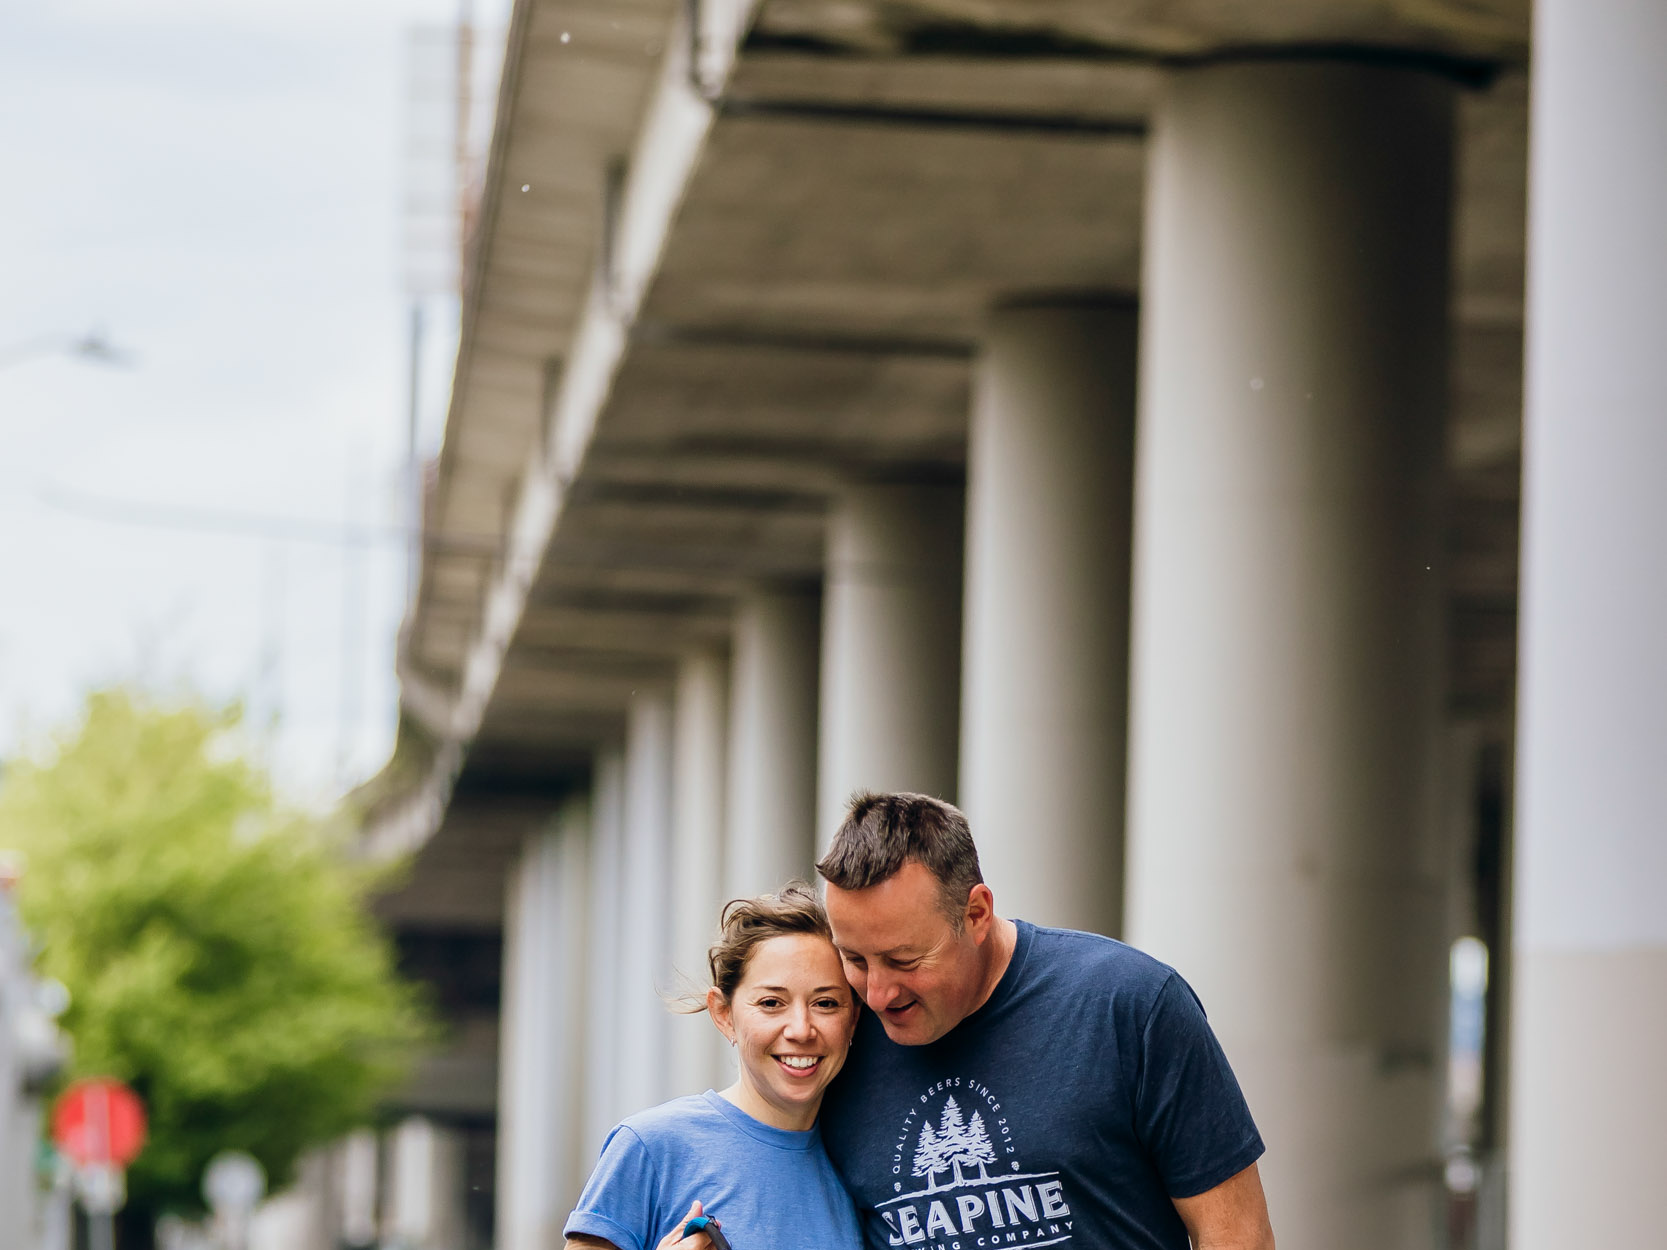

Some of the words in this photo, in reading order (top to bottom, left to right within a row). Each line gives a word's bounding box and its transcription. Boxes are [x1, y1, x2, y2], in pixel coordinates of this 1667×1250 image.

[893, 1108, 917, 1174] QUALITY
[920, 1077, 960, 1103] BEERS
[968, 1079, 1001, 1112] SINCE
[998, 1118, 1015, 1154] 2012
[977, 1221, 1074, 1246] COMPANY
